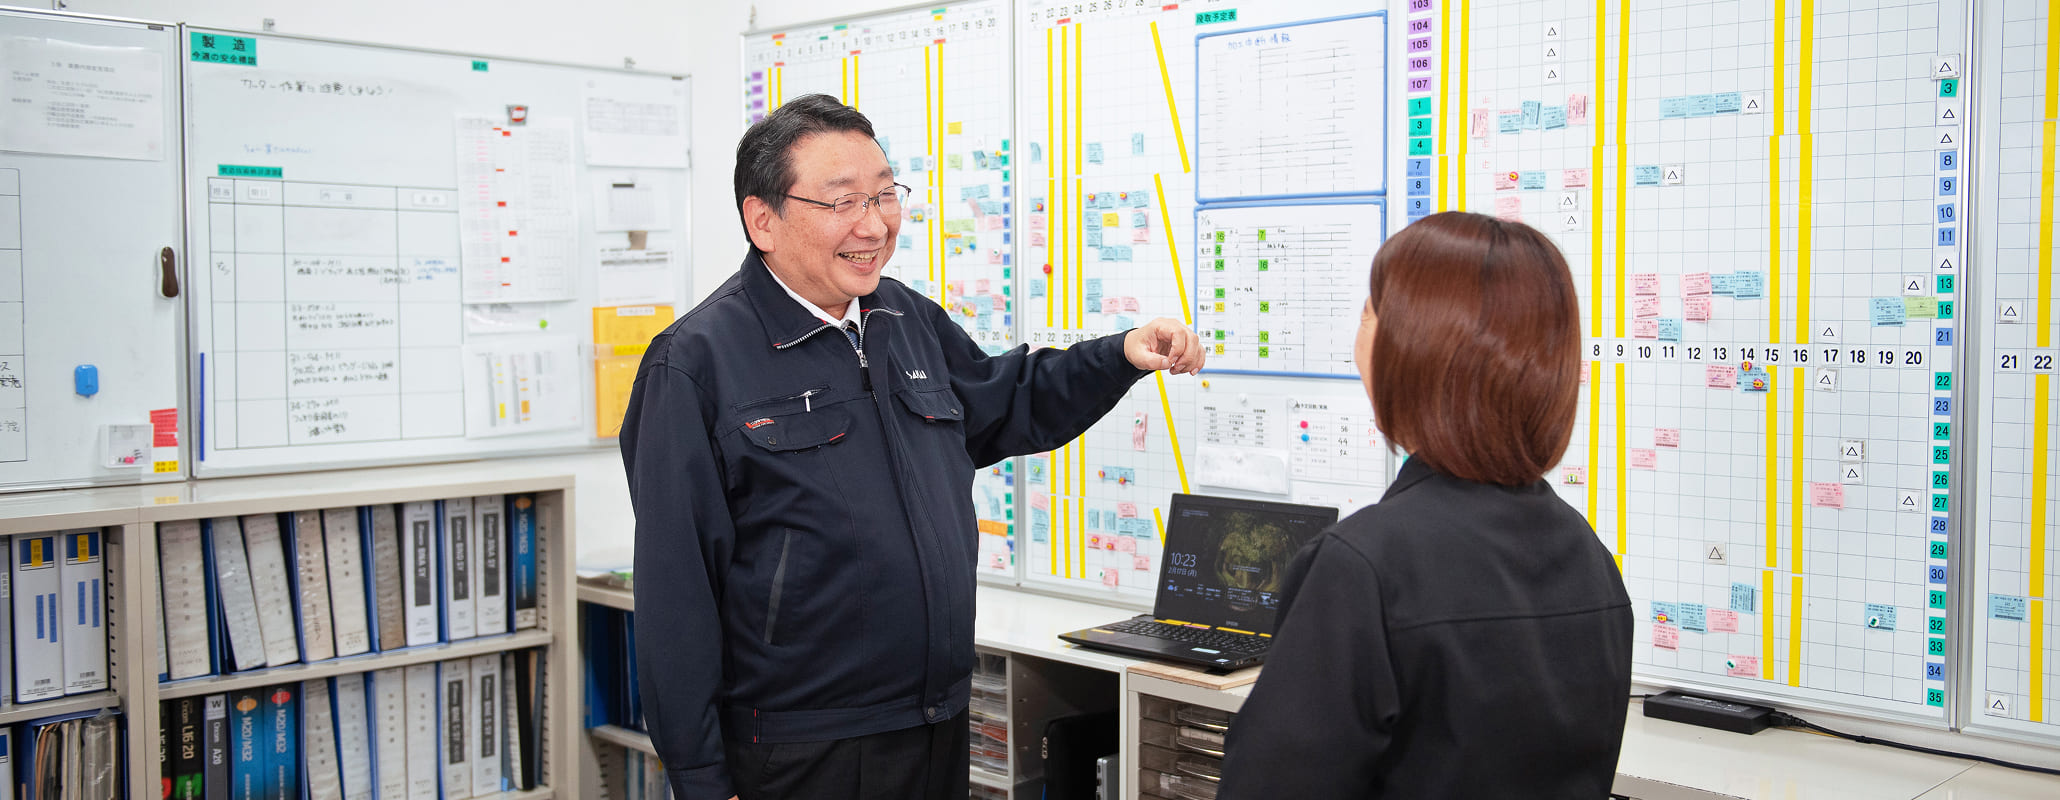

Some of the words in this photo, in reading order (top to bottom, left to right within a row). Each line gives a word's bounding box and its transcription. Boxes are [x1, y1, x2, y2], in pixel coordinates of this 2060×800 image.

[1412, 21, 1428, 31] 104
[202, 35, 246, 52] 製造
[1412, 40, 1428, 49] 105
[1412, 59, 1428, 68] 106
[1412, 80, 1428, 88] 107
[1944, 83, 1952, 94] 3
[1418, 100, 1421, 109] 1
[1417, 121, 1422, 129] 3
[1416, 161, 1421, 169] 7
[1944, 155, 1952, 166] 8
[1416, 181, 1421, 189] 8
[1944, 180, 1951, 191] 9
[1940, 207, 1953, 218] 10
[1941, 231, 1952, 241] 11
[1940, 278, 1952, 289] 13
[1940, 305, 1951, 315] 16
[1033, 333, 1041, 341] 21
[1048, 333, 1056, 342] 22
[1937, 331, 1950, 341] 21
[1593, 344, 1600, 356] 8
[1616, 344, 1624, 356] 9
[1638, 346, 1651, 358] 10
[1663, 346, 1675, 358] 11
[1688, 348, 1701, 360] 12
[1713, 348, 1727, 360] 13
[1741, 348, 1755, 360] 14
[1765, 348, 1779, 362] 15
[1793, 349, 1808, 362] 16
[1823, 349, 1838, 362] 17
[1850, 350, 1866, 363] 18
[1878, 351, 1894, 364] 19
[1905, 351, 1922, 365] 20
[2001, 354, 2017, 369] 21
[2034, 355, 2052, 369] 22
[1937, 376, 1950, 386] 22
[1936, 401, 1949, 411] 23
[1936, 426, 1948, 436] 24
[1935, 450, 1948, 460] 25
[1935, 475, 1947, 485] 26
[1934, 498, 1946, 508] 27
[1933, 520, 1946, 531] 28
[1932, 544, 1944, 555] 29
[1171, 552, 1196, 567] 10:23
[1931, 569, 1944, 580] 30
[1931, 594, 1942, 604] 31
[1930, 620, 1943, 631] 32
[1930, 641, 1943, 652] 33
[1928, 666, 1941, 676] 34
[1929, 692, 1942, 703] 35
[212, 700, 222, 708] W
[276, 709, 287, 753] M20/M32
[242, 717, 252, 761] M20/M32
[213, 748, 222, 765] A20
